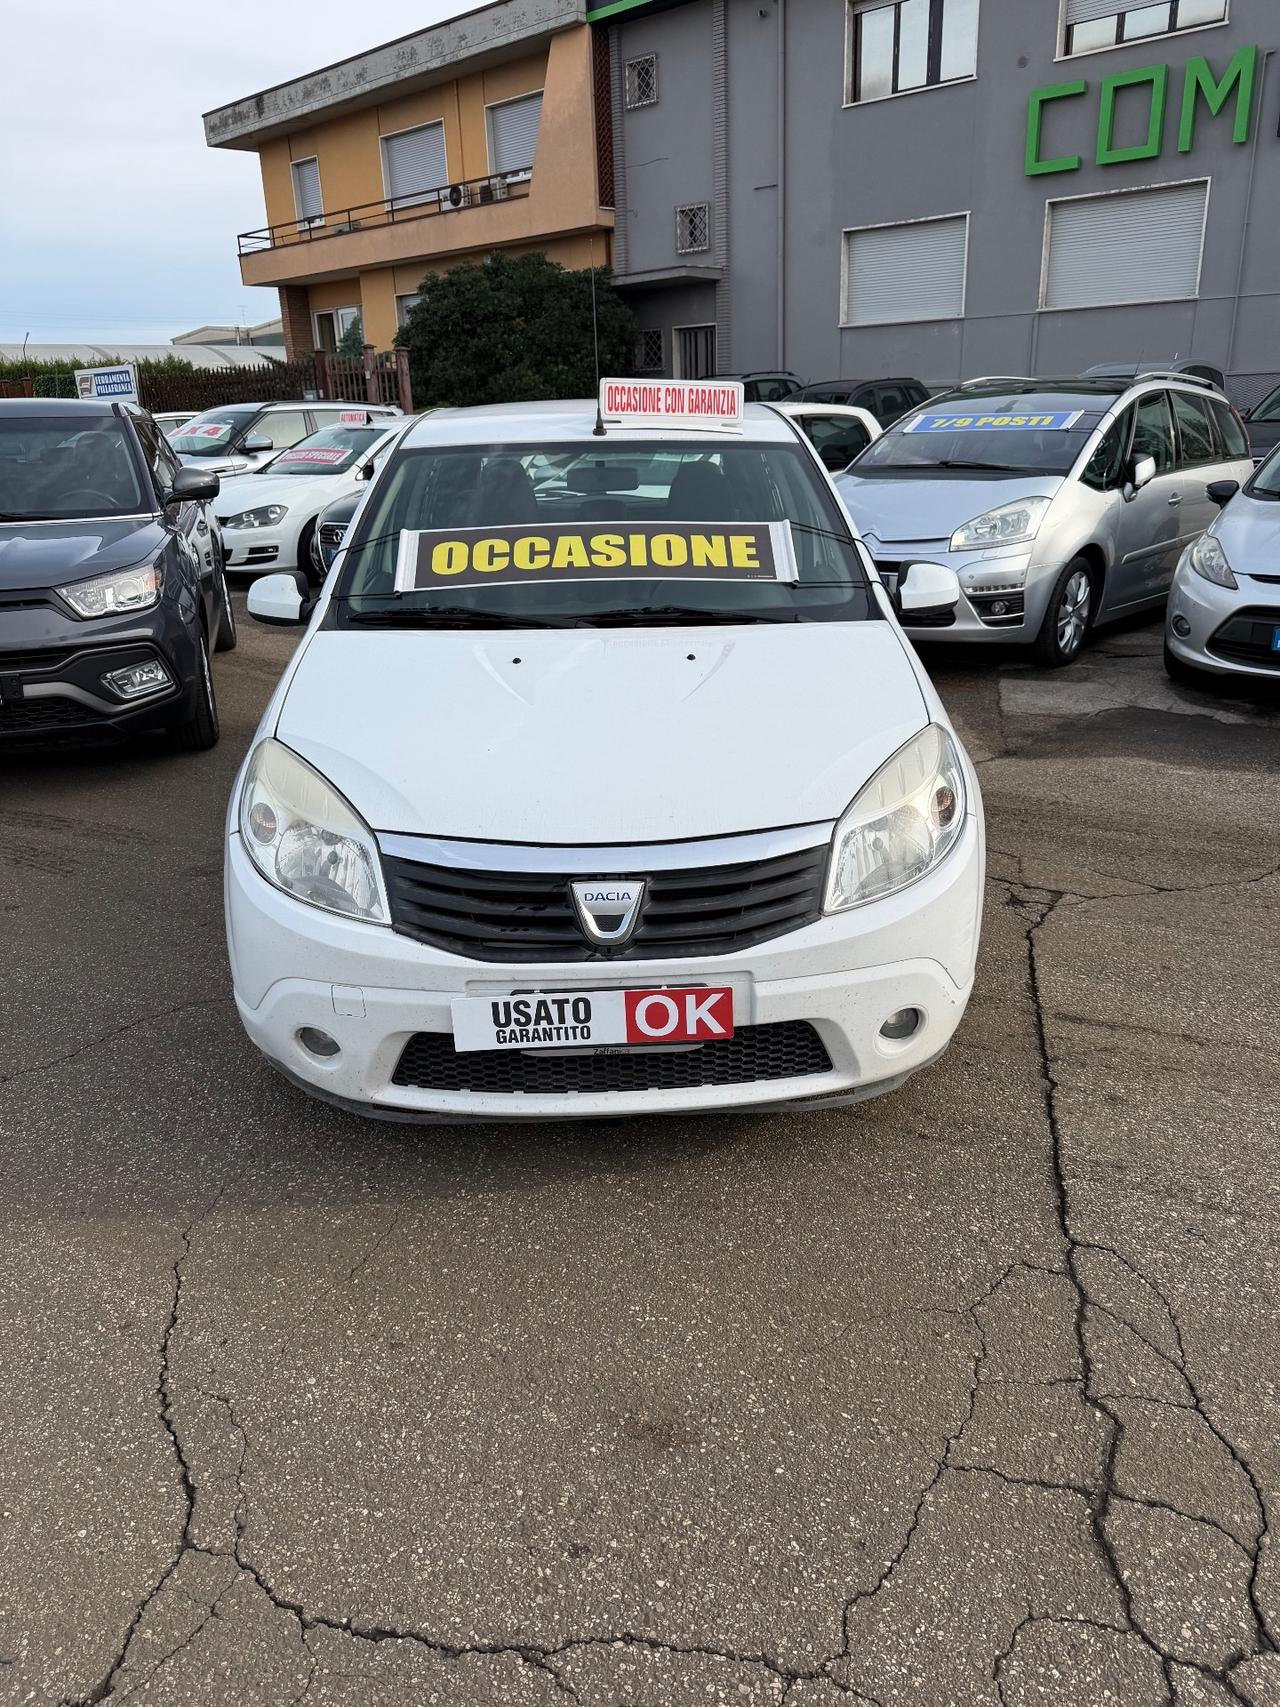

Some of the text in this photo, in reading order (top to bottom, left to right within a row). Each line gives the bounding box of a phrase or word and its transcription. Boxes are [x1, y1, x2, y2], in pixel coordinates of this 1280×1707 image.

[94, 373, 130, 385] FERRAMENTA
[97, 382, 132, 394] VILLAFRANCA
[607, 385, 736, 416] OCCASIONE CON GARANZIA
[931, 415, 1055, 428] 7/9 POSTI
[431, 533, 761, 575] OCCASIONE
[584, 892, 632, 901] DACIA
[491, 992, 727, 1037] USATO OK
[496, 1025, 591, 1044] GARANTITO
